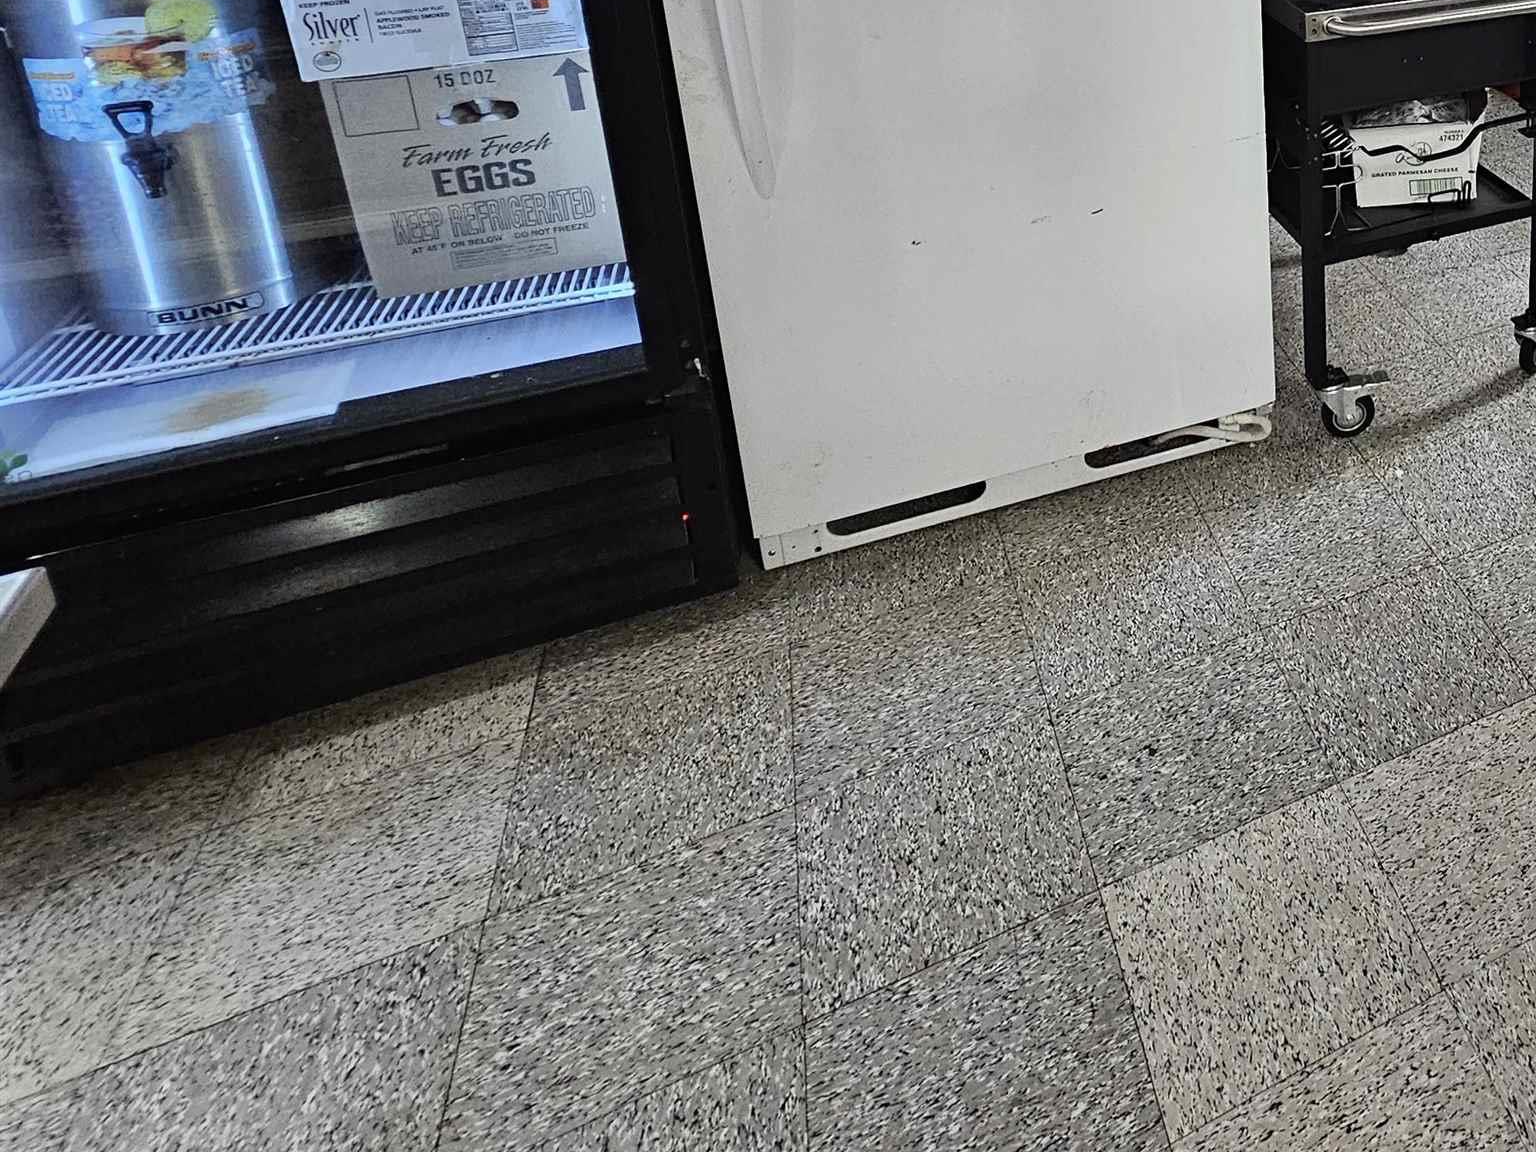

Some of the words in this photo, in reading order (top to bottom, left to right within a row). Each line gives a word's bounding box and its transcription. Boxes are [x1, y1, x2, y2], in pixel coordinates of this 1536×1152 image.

[319, 0, 350, 7] FROZEN
[303, 11, 361, 41] Silver
[433, 73, 455, 89] 15
[460, 69, 497, 87] DOZ
[402, 143, 474, 168] Farm
[480, 132, 553, 159] Fresh
[431, 158, 536, 197] EGGS
[391, 206, 445, 246] KEEP
[449, 186, 597, 238] REFRIGERATED
[467, 235, 503, 246] BELOW
[513, 231, 530, 239] DO
[530, 227, 551, 236] NOT
[552, 221, 590, 234] FREEZE
[156, 298, 249, 324] BUNN
